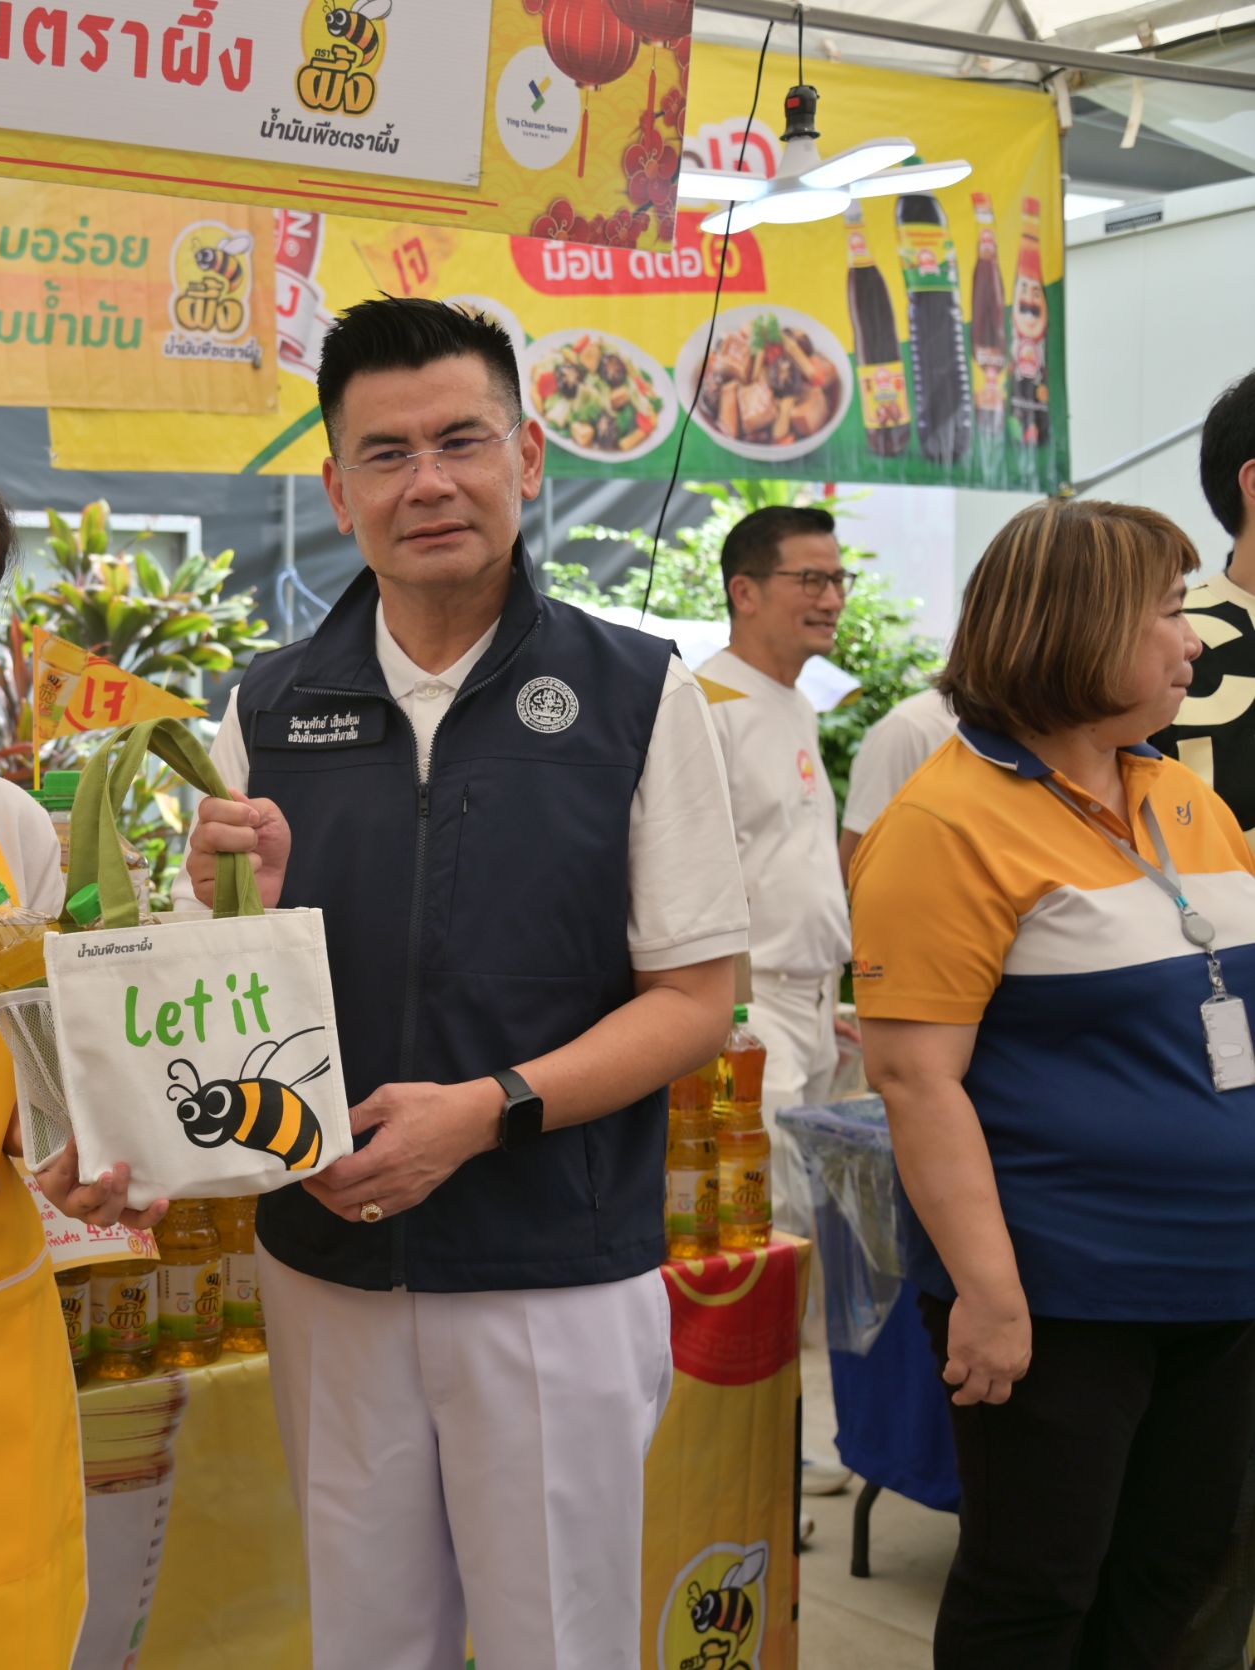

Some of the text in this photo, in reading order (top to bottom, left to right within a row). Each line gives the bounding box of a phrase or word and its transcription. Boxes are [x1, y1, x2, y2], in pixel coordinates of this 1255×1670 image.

[297, 44, 376, 114] ผึ้ง
[260, 108, 399, 154] น้ำมันพืชตราผึ้ง
[77, 937, 153, 959] น้ำมันพืชตราผึ้ง
[226, 972, 271, 1036] it
